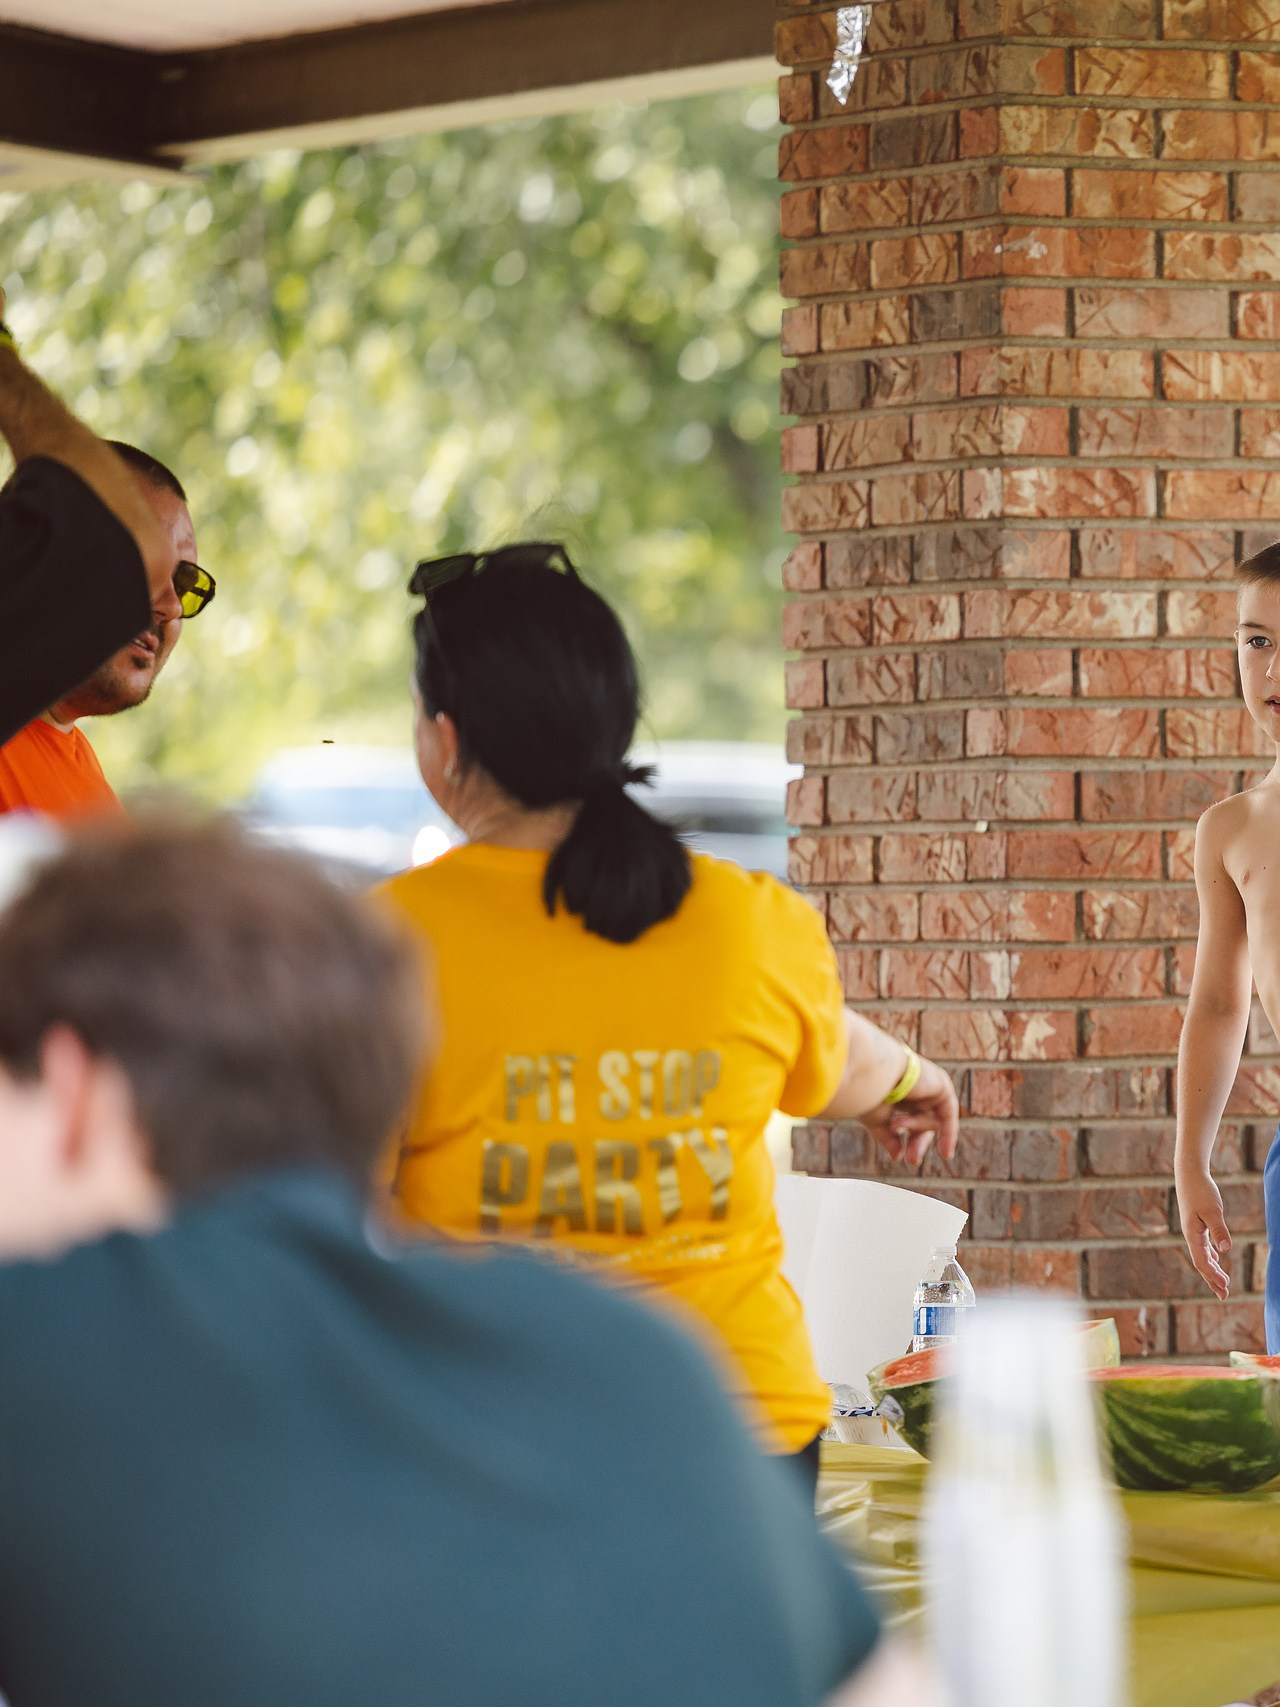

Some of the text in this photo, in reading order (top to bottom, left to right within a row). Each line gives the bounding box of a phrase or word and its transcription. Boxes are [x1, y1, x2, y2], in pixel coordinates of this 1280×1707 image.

[504, 1050, 721, 1124] PIT STOP
[480, 1128, 733, 1237] PARTY
